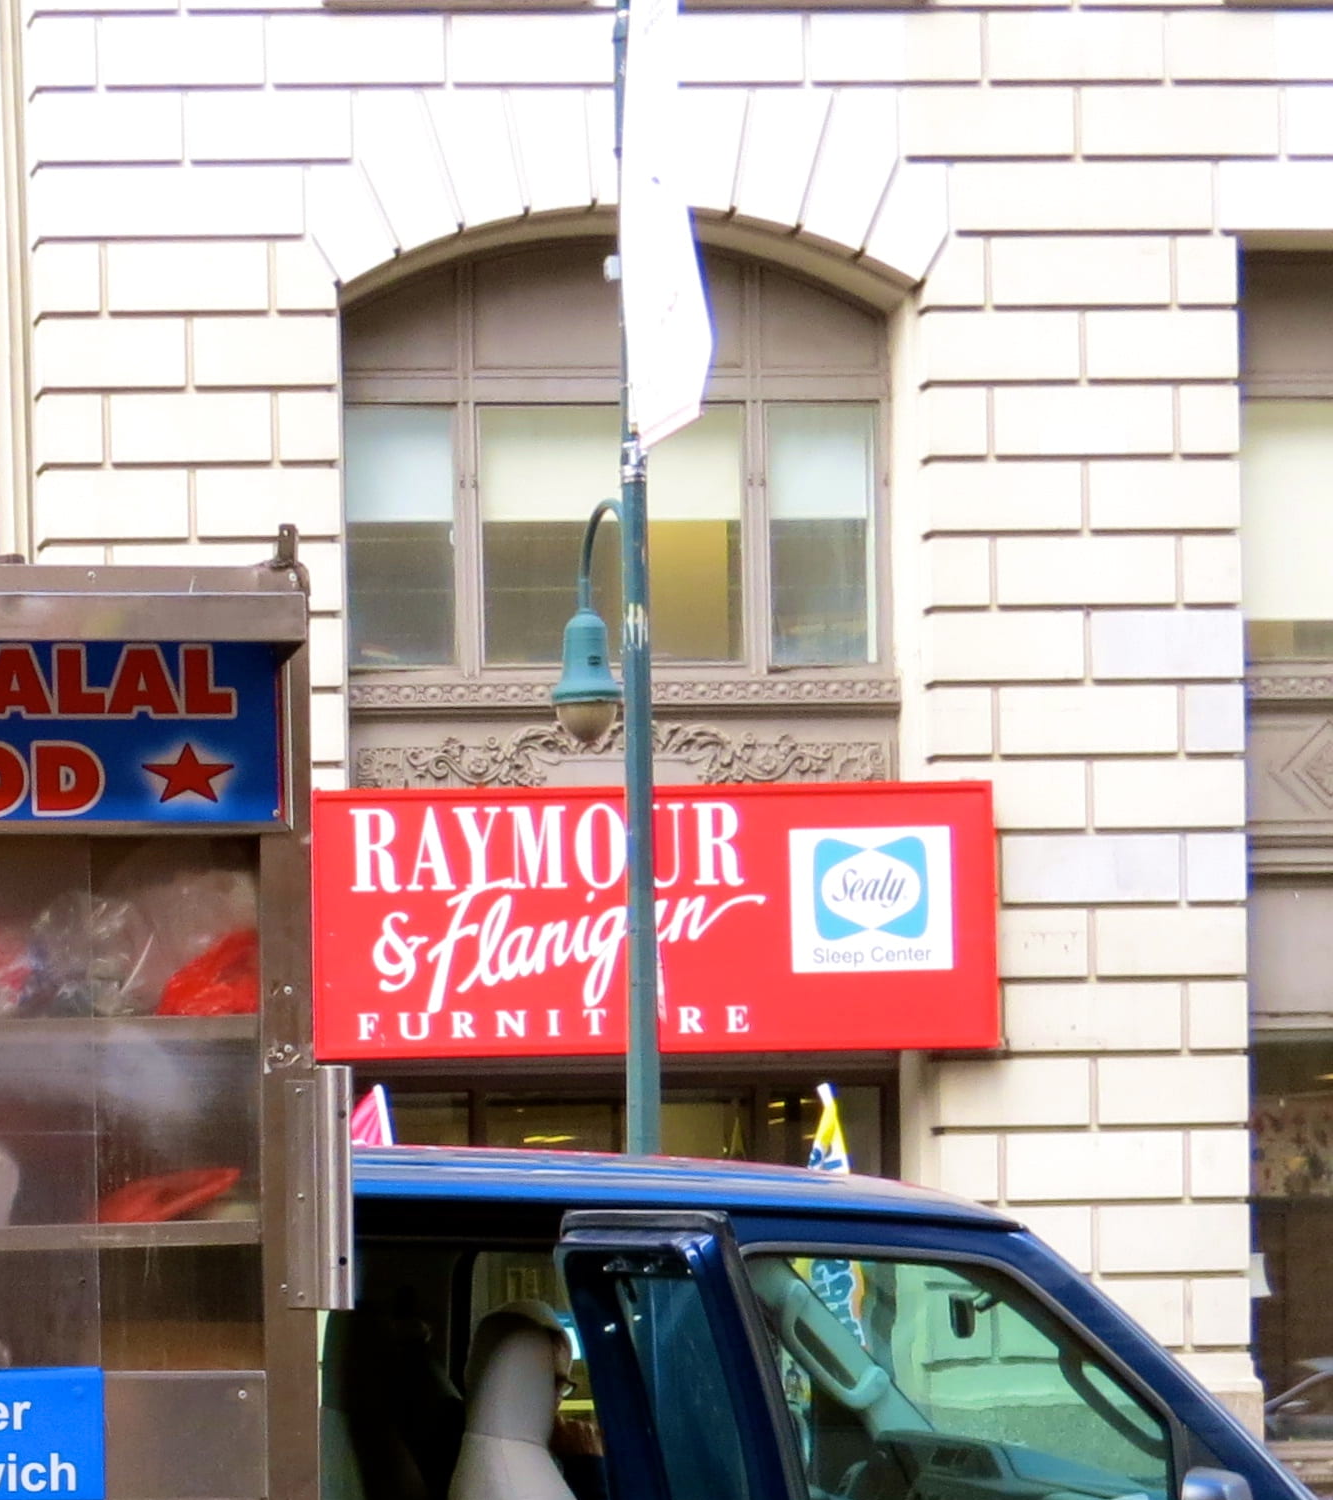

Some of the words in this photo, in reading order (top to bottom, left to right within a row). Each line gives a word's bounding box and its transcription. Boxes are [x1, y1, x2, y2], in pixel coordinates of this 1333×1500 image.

[832, 867, 906, 907] Sealy
[373, 912, 428, 992] &
[427, 876, 765, 1014] Flanign
[813, 947, 864, 967] Sleep
[871, 946, 931, 962] Center
[357, 1006, 750, 1040] FURNITRE
